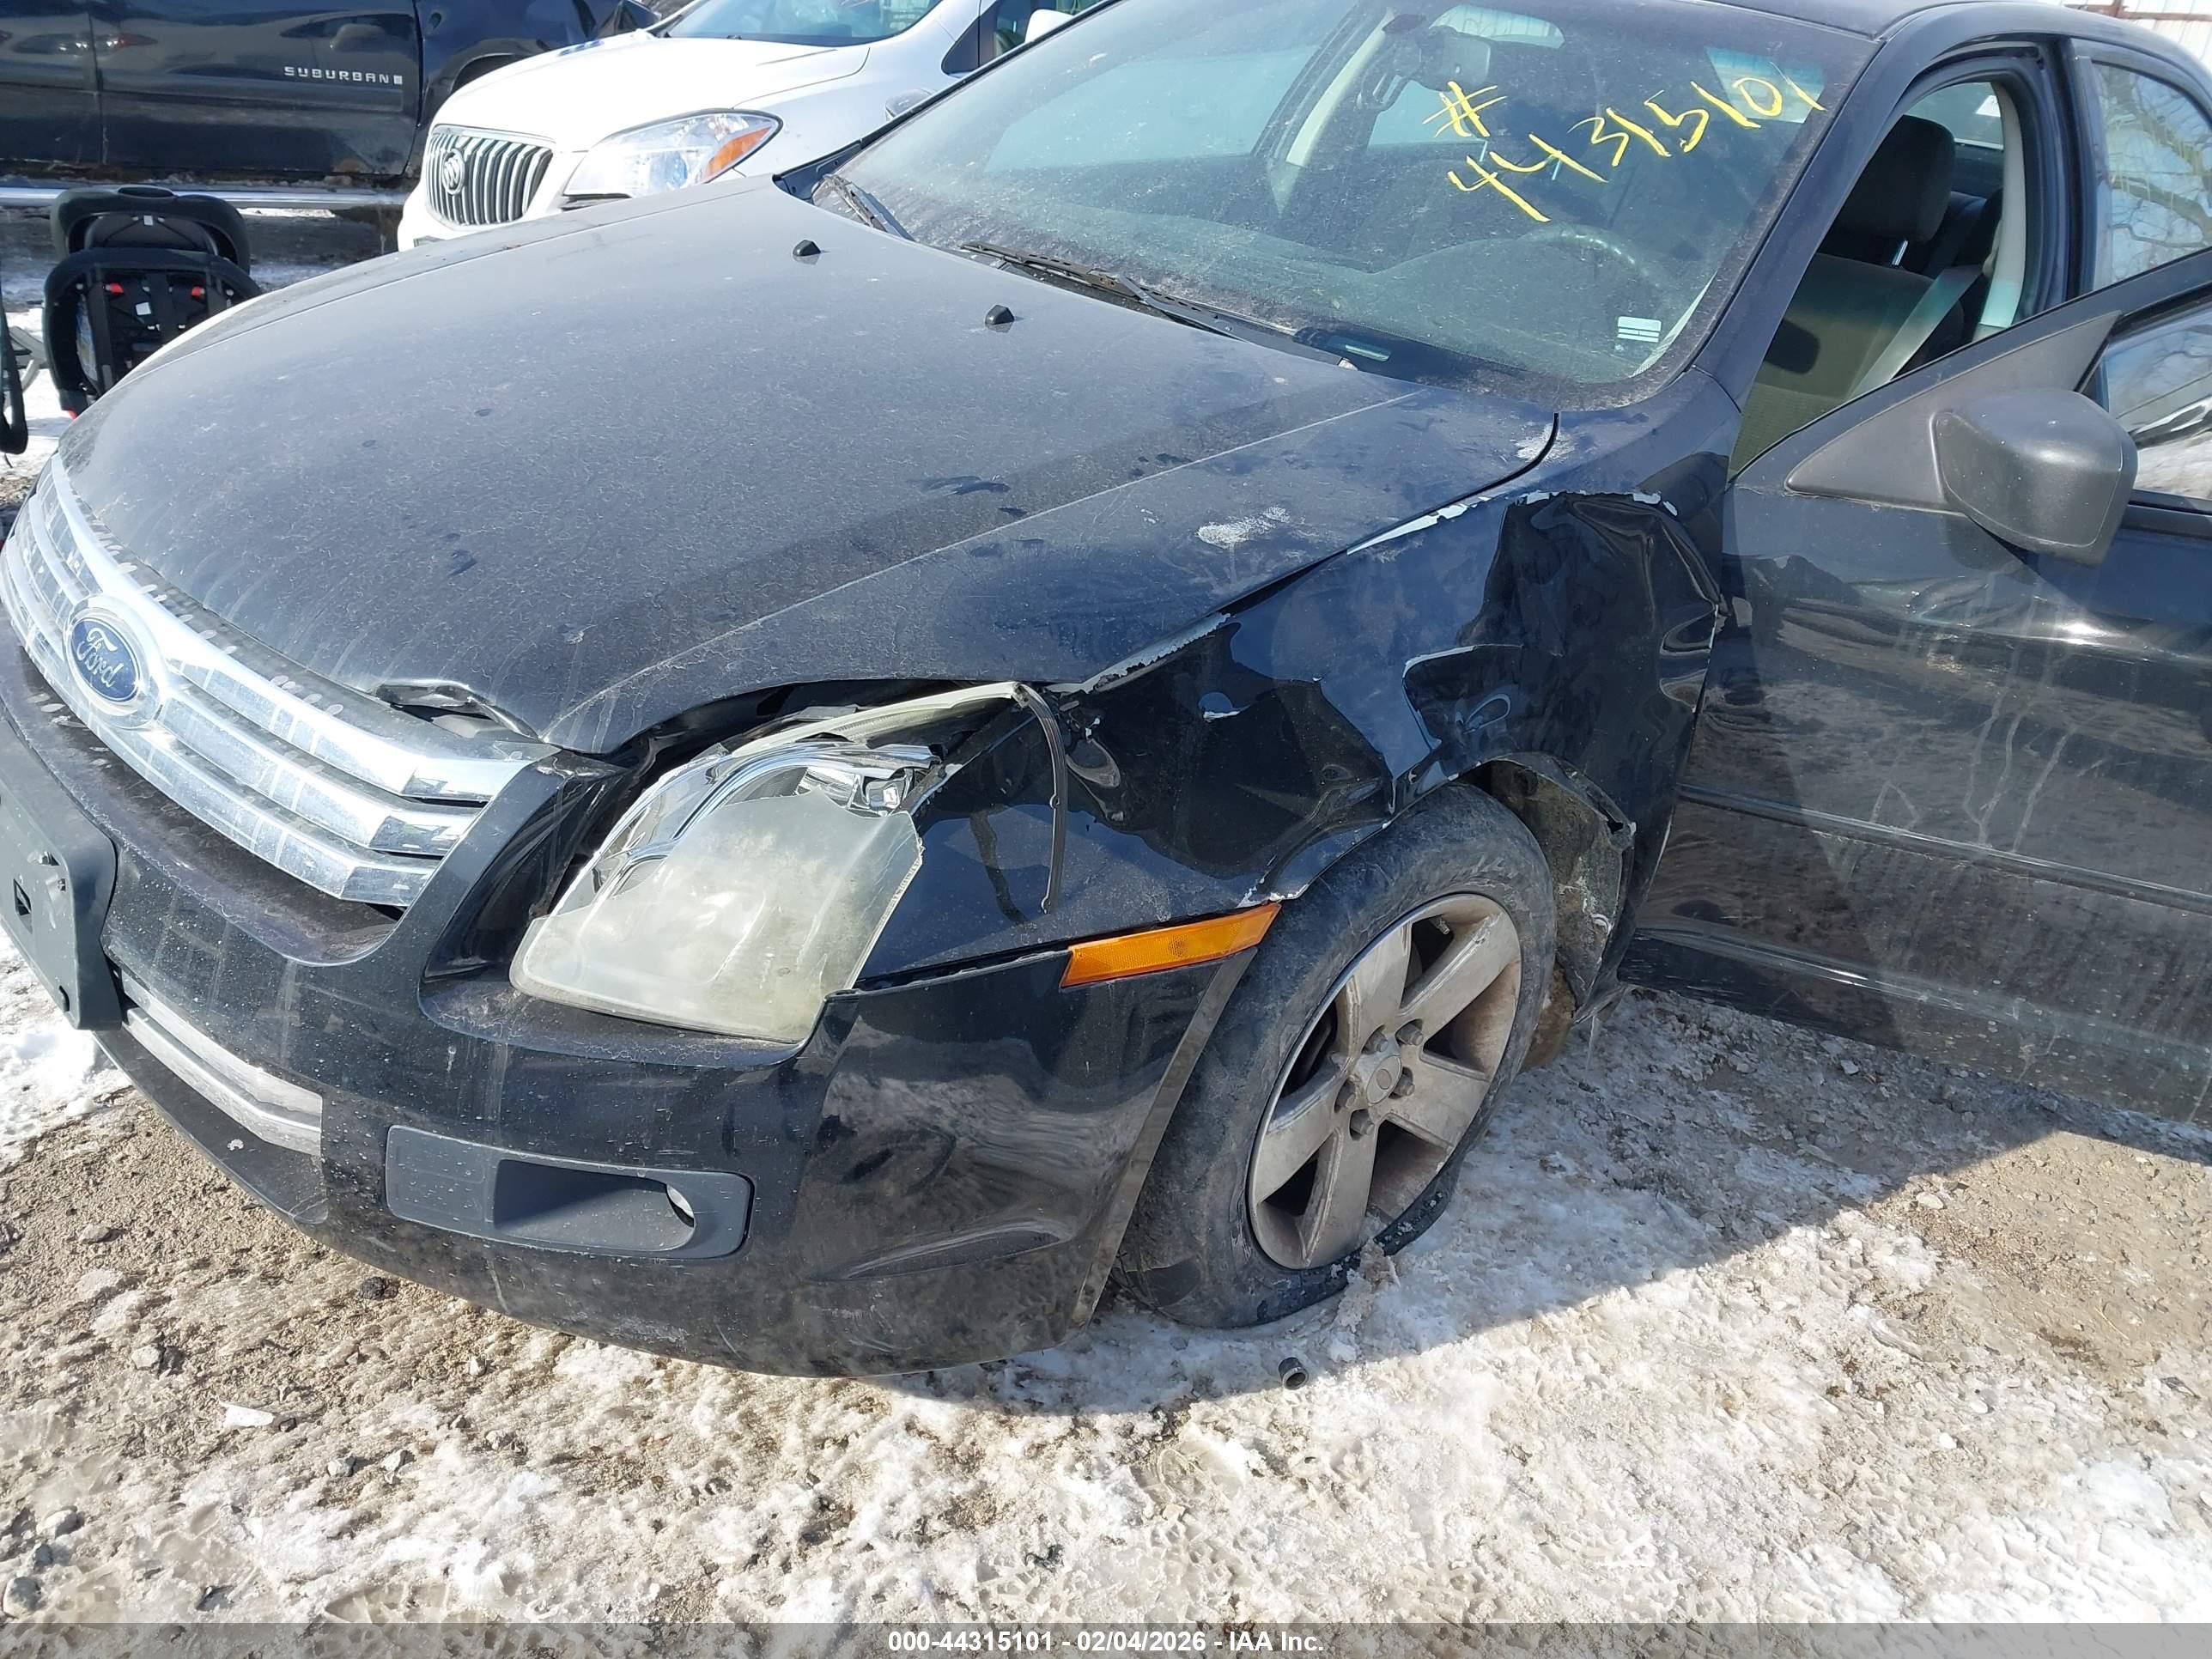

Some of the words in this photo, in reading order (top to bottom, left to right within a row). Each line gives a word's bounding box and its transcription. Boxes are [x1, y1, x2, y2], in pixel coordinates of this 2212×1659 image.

[284, 66, 389, 84] SUBURBAN
[1423, 81, 1508, 137] #
[1447, 64, 1828, 222] 44315101
[76, 628, 125, 688] Ford
